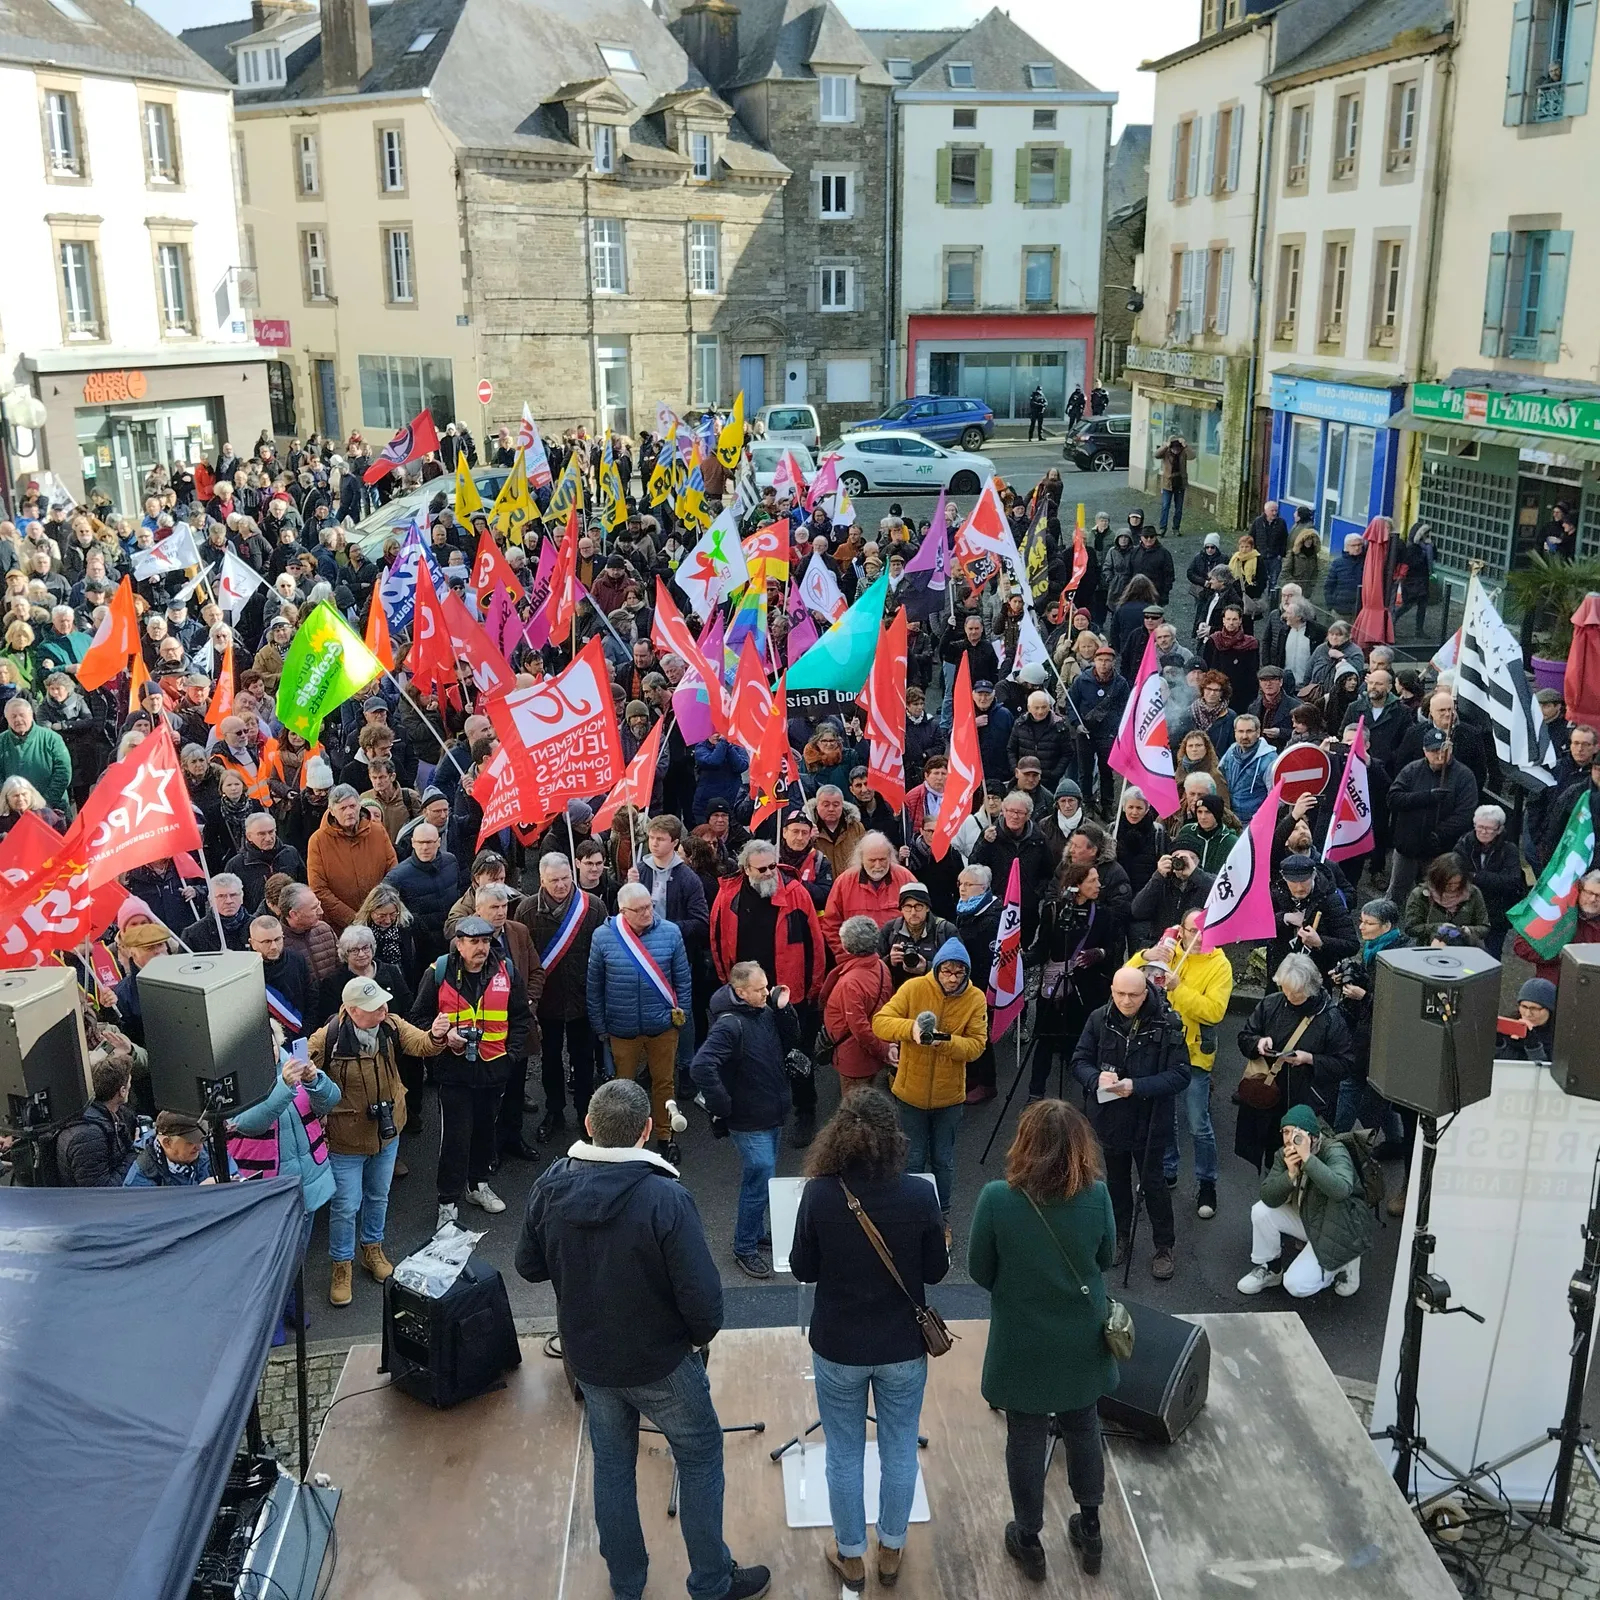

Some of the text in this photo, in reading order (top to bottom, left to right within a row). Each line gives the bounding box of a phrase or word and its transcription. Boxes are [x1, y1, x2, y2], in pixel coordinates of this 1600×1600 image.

[87, 370, 127, 388] ouest
[84, 385, 127, 402] france
[1316, 385, 1389, 407] MICRO-INFORMATIQUE
[915, 464, 934, 475] ATR
